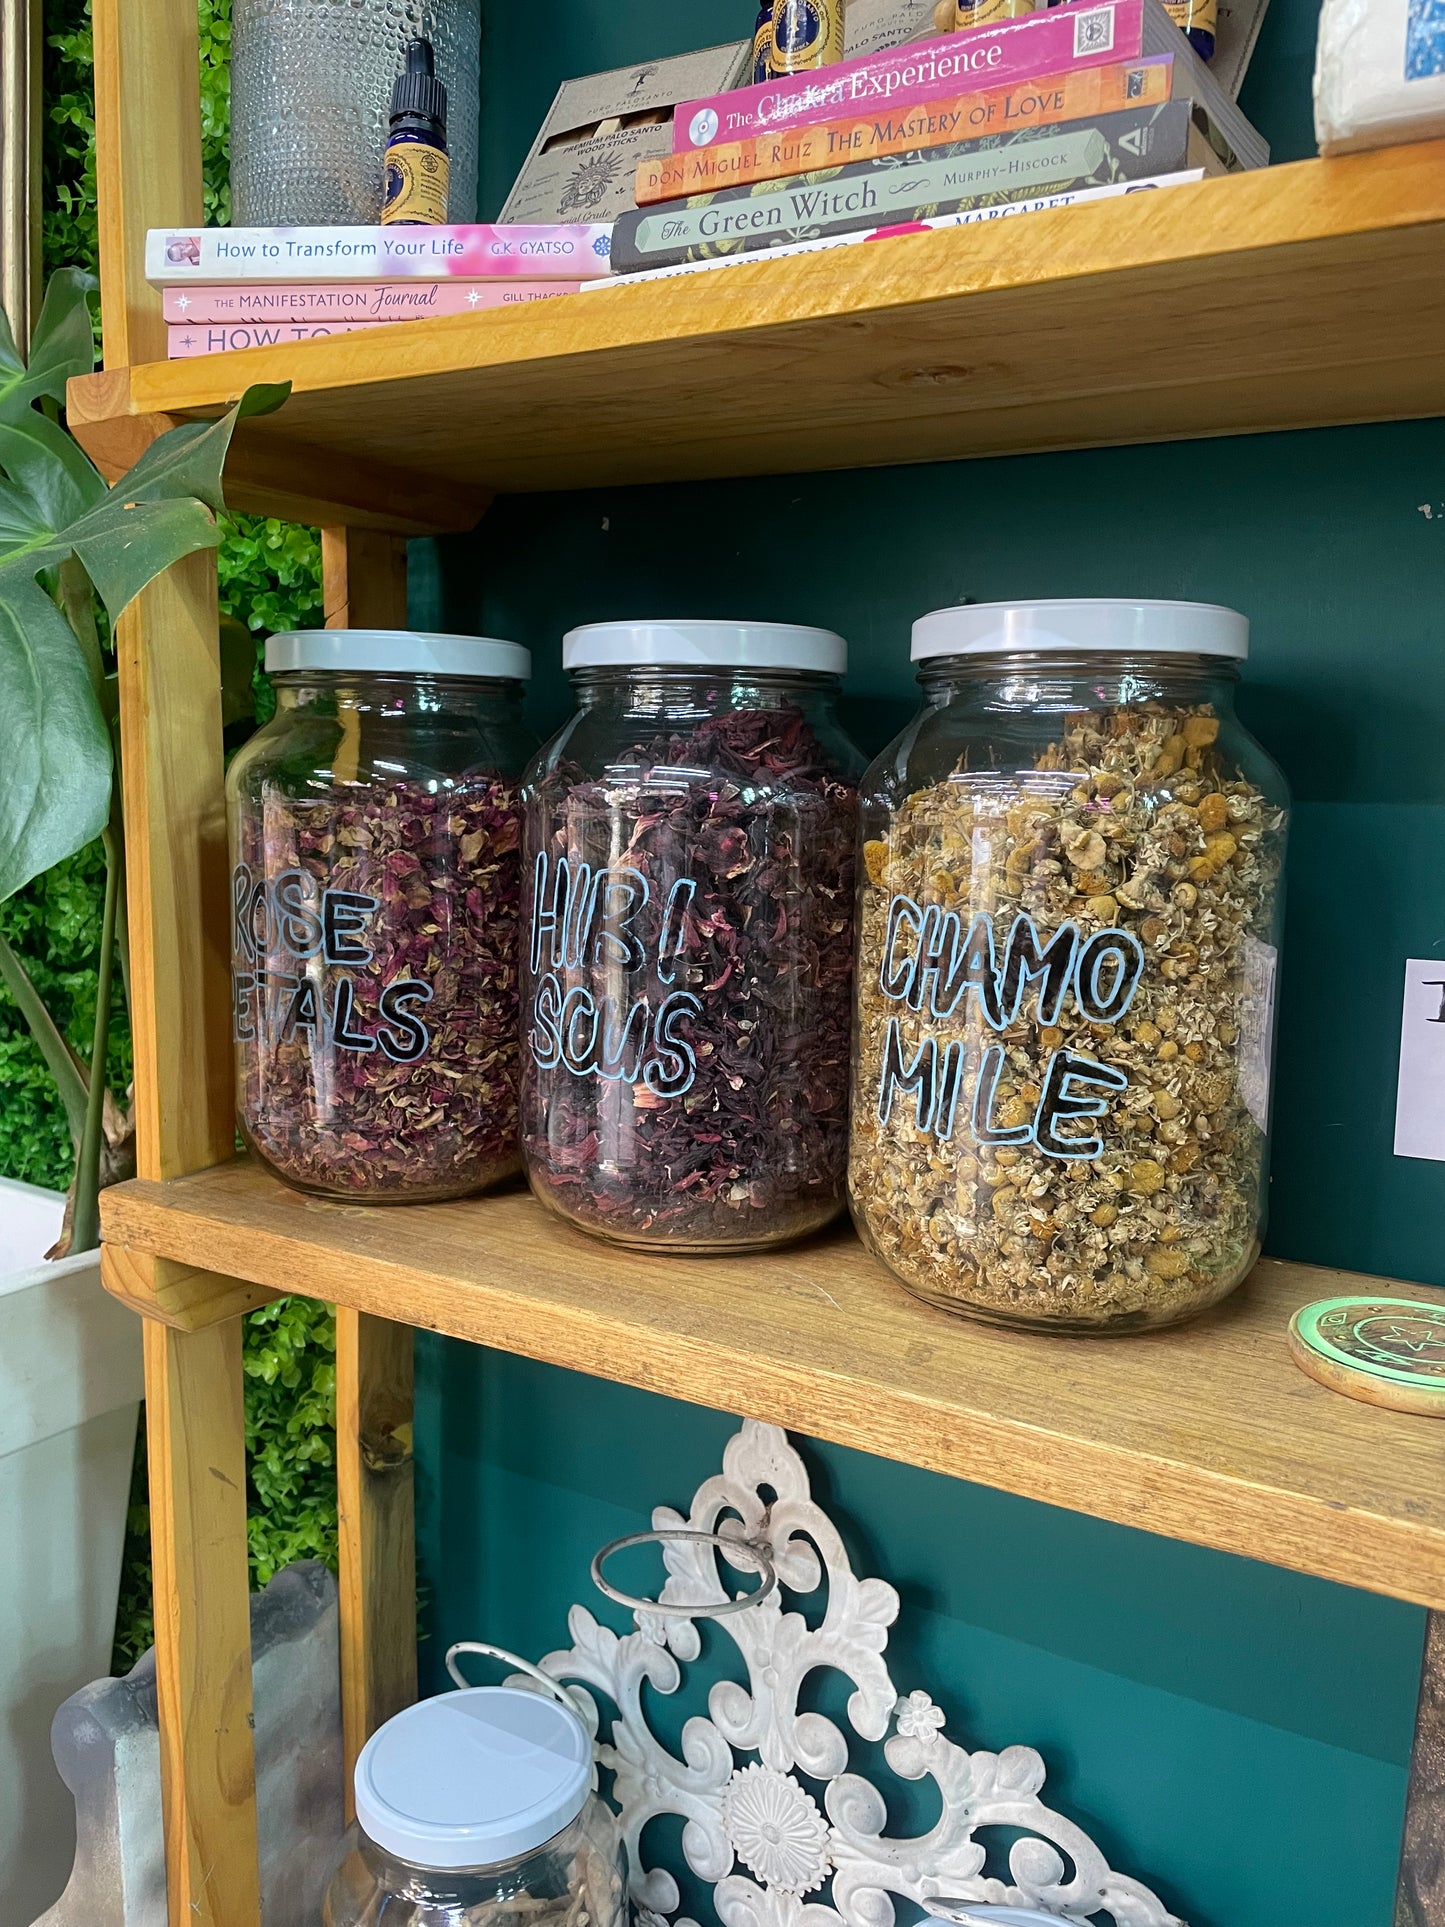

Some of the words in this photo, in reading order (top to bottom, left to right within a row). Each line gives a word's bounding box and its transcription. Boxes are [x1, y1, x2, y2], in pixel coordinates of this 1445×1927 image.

[872, 27, 912, 41] SANTO
[727, 112, 753, 130] The
[849, 44, 1002, 100] Experience
[563, 137, 603, 155] PREMIUM
[604, 131, 628, 142] PALO
[629, 125, 662, 136] SANTO
[827, 130, 863, 153] THE
[869, 110, 960, 145] MASTERY
[969, 104, 996, 126] OF
[1004, 90, 1065, 120] LOVE
[577, 143, 606, 156] WOOD
[607, 136, 639, 149] STICKS
[649, 168, 685, 188] DON
[692, 154, 762, 178] MIGUEL
[772, 142, 811, 163] RUIZ
[661, 220, 691, 241] The
[699, 207, 782, 236] Green
[790, 180, 877, 220] Witch
[217, 242, 256, 258] How
[262, 243, 280, 257] to
[286, 240, 376, 257] Transform
[384, 239, 426, 256] Your
[432, 239, 464, 255] Life
[491, 242, 516, 255] G.K.
[520, 241, 575, 255] GYATSO
[214, 299, 234, 308] THE
[239, 293, 367, 308] MANIFESTATION
[370, 284, 439, 315] Journal
[503, 293, 524, 302] GILL
[208, 328, 281, 351] HOW
[233, 863, 379, 966] ROSE
[880, 894, 1145, 1031] CHAMO
[231, 961, 433, 1062] ETALS
[878, 1017, 1129, 1160] MILE
